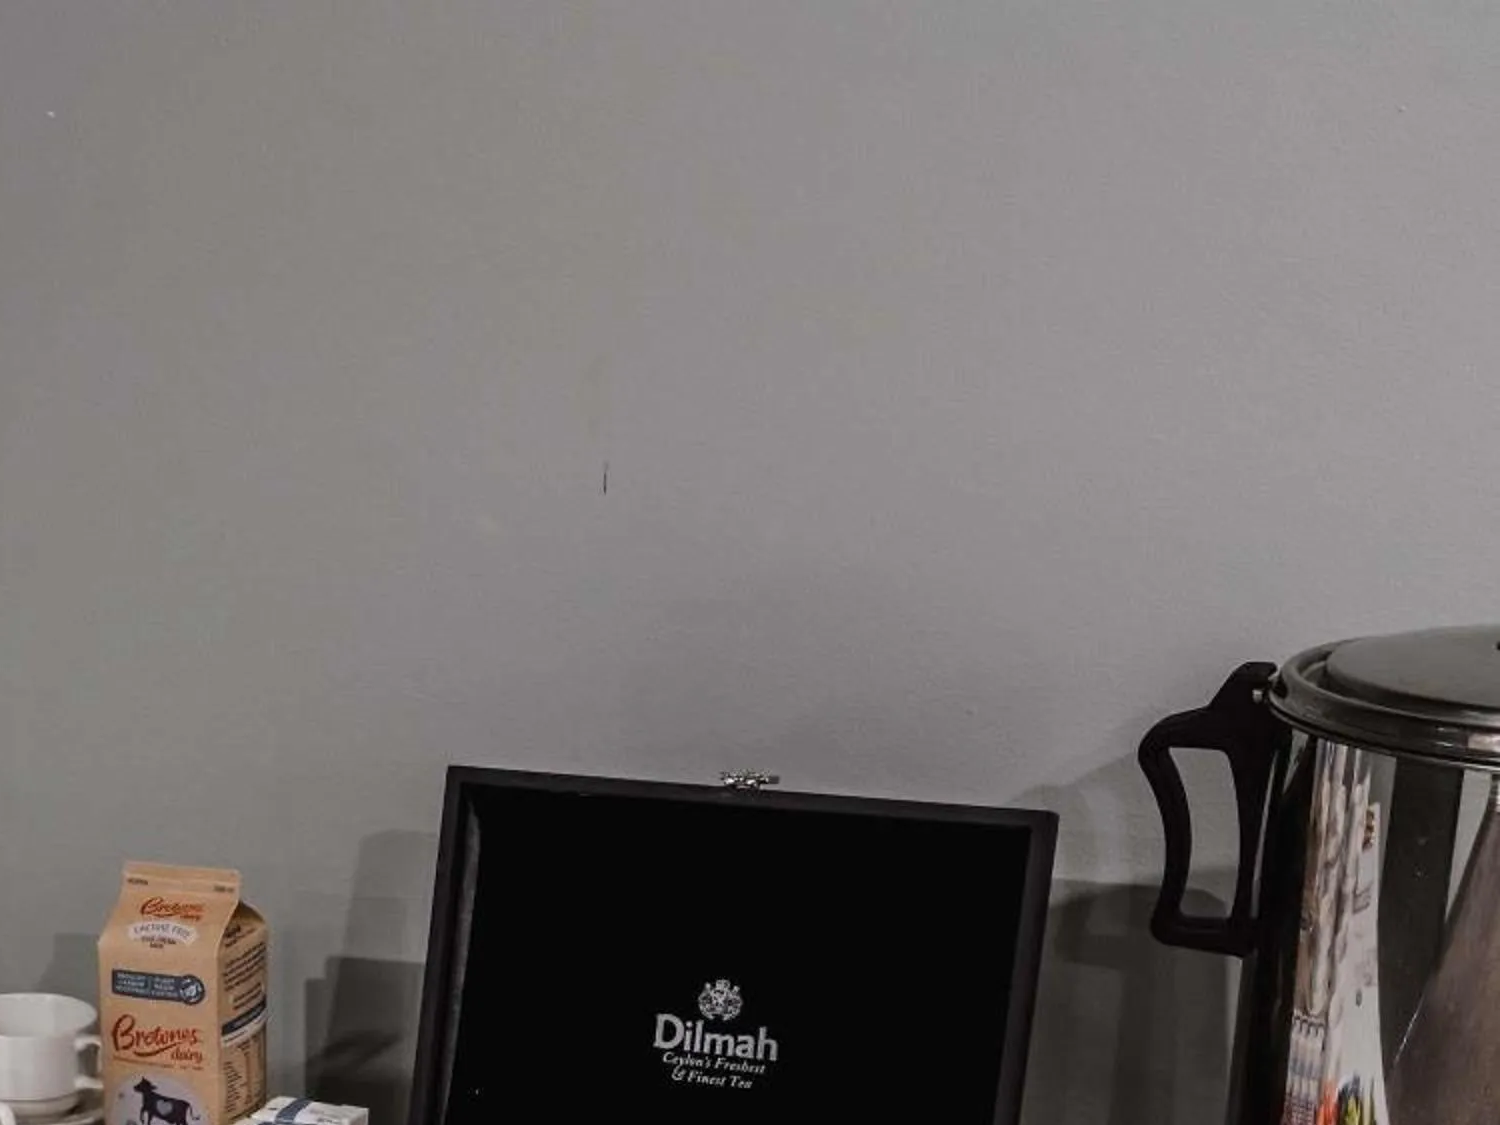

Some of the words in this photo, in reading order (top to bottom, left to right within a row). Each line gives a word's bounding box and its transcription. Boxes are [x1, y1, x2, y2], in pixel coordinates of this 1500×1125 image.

[653, 1013, 779, 1062] Dilmah
[662, 1051, 712, 1069] Ceylon's
[714, 1057, 766, 1074] Freshest
[687, 1069, 727, 1087] Finest
[728, 1075, 754, 1089] Tea
